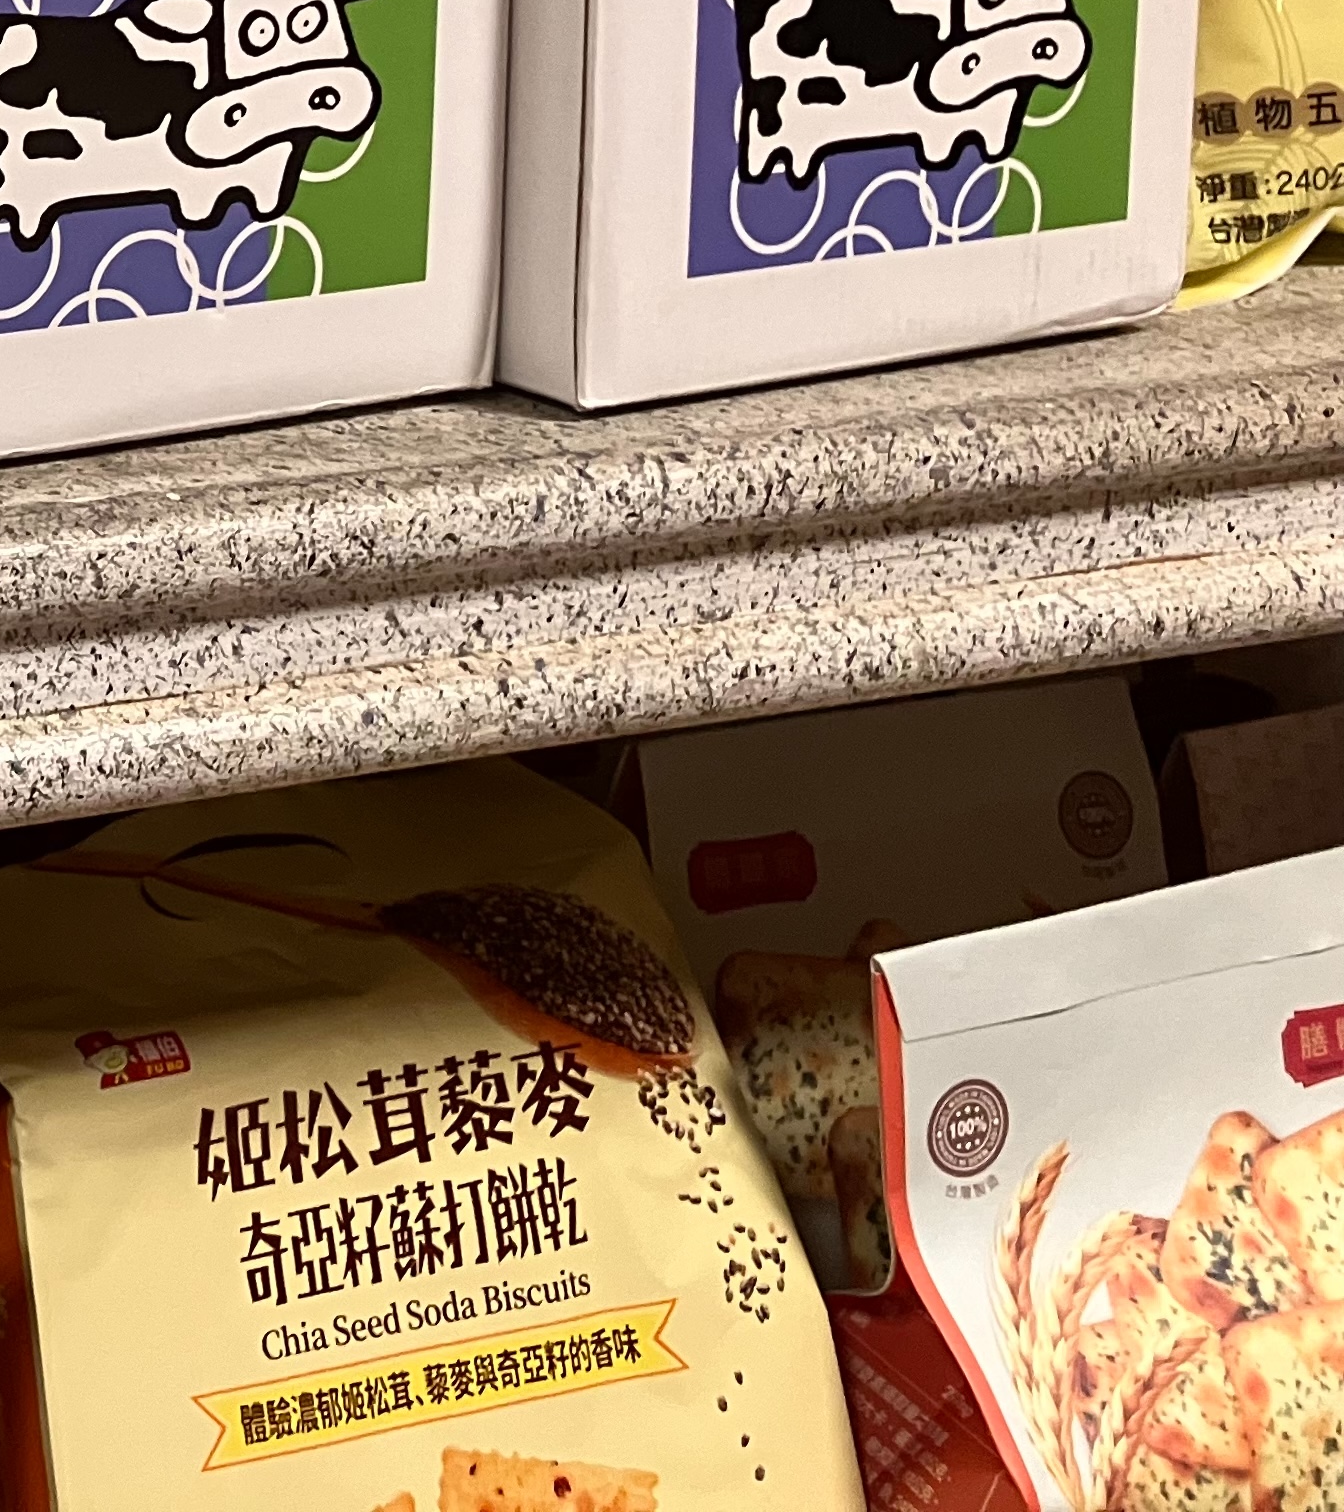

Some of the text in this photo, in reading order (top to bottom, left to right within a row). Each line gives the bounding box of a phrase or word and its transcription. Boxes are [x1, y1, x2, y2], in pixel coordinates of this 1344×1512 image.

[193, 1040, 596, 1203] 姬松茸藜麥
[239, 1156, 590, 1307] 奇亞籽蘇打餅乾
[260, 1268, 593, 1361] Chia Seed Soda Biscuits
